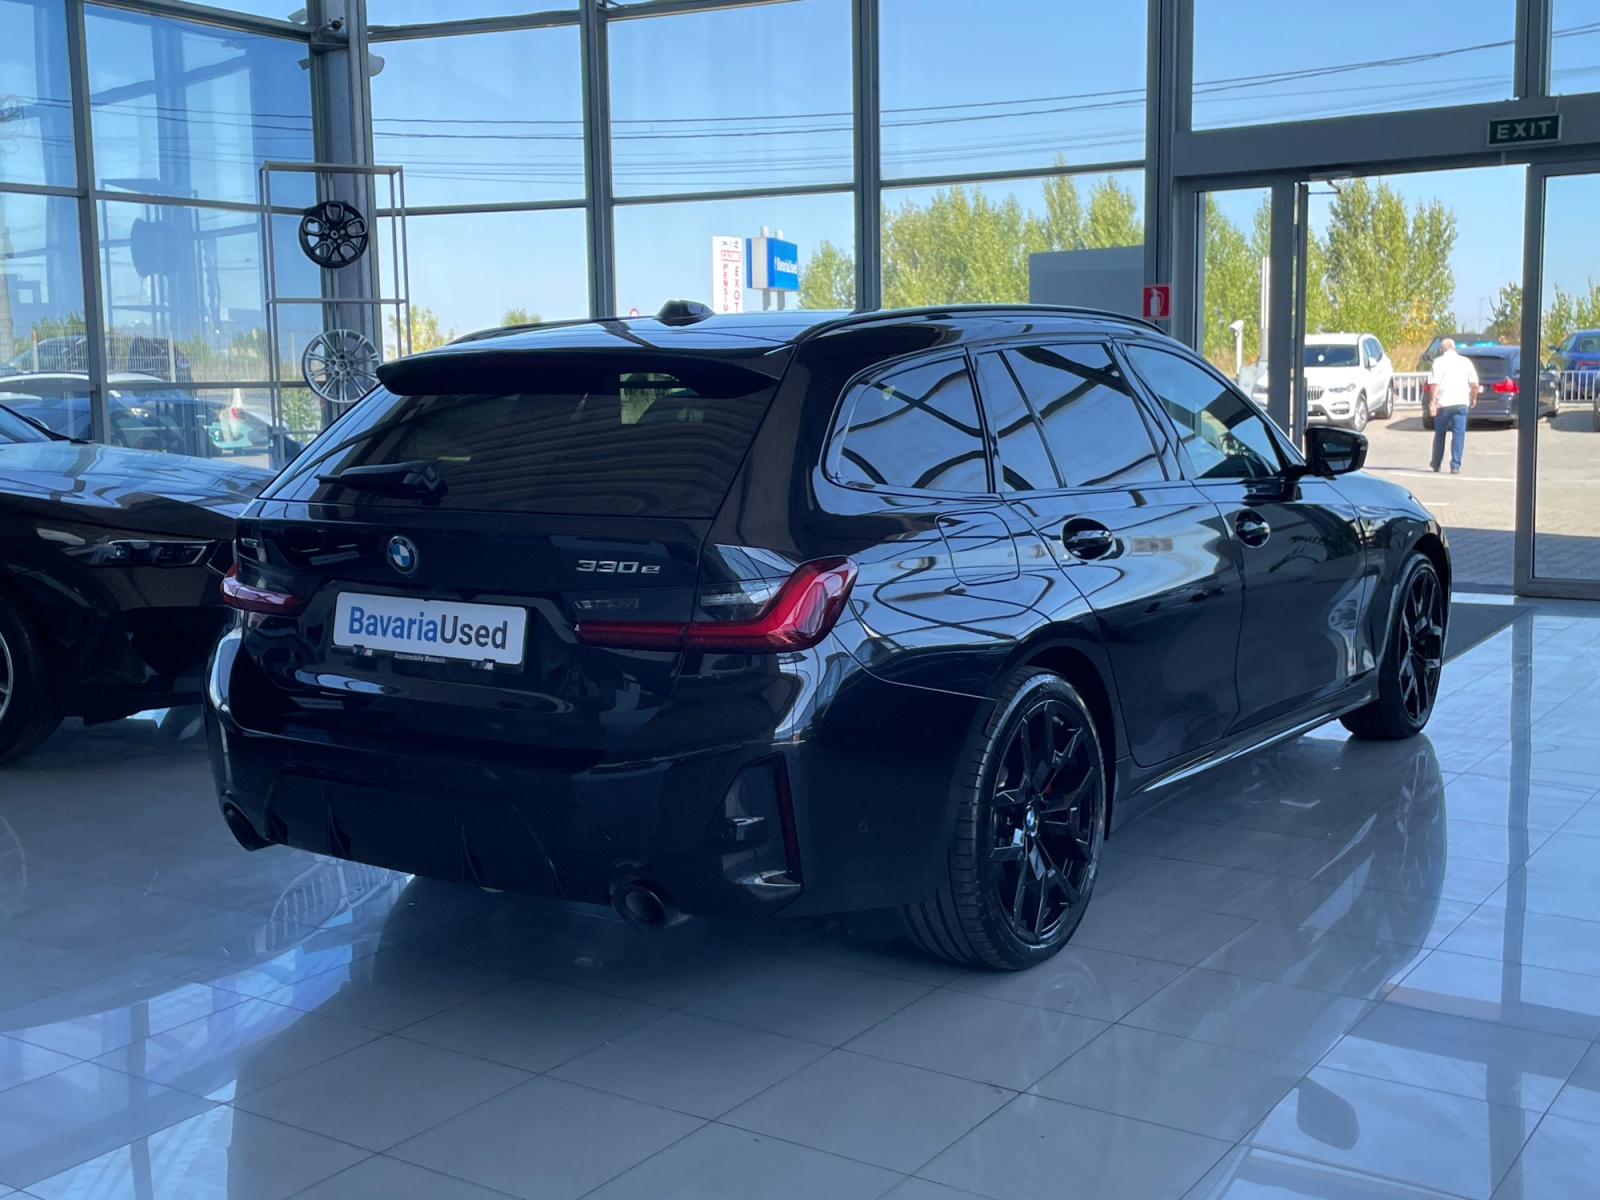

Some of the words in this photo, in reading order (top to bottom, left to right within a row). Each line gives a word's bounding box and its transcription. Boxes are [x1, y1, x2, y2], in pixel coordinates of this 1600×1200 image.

[1496, 121, 1552, 139] EXIT
[576, 559, 661, 574] 330e
[348, 606, 508, 650] BavariaUsed
